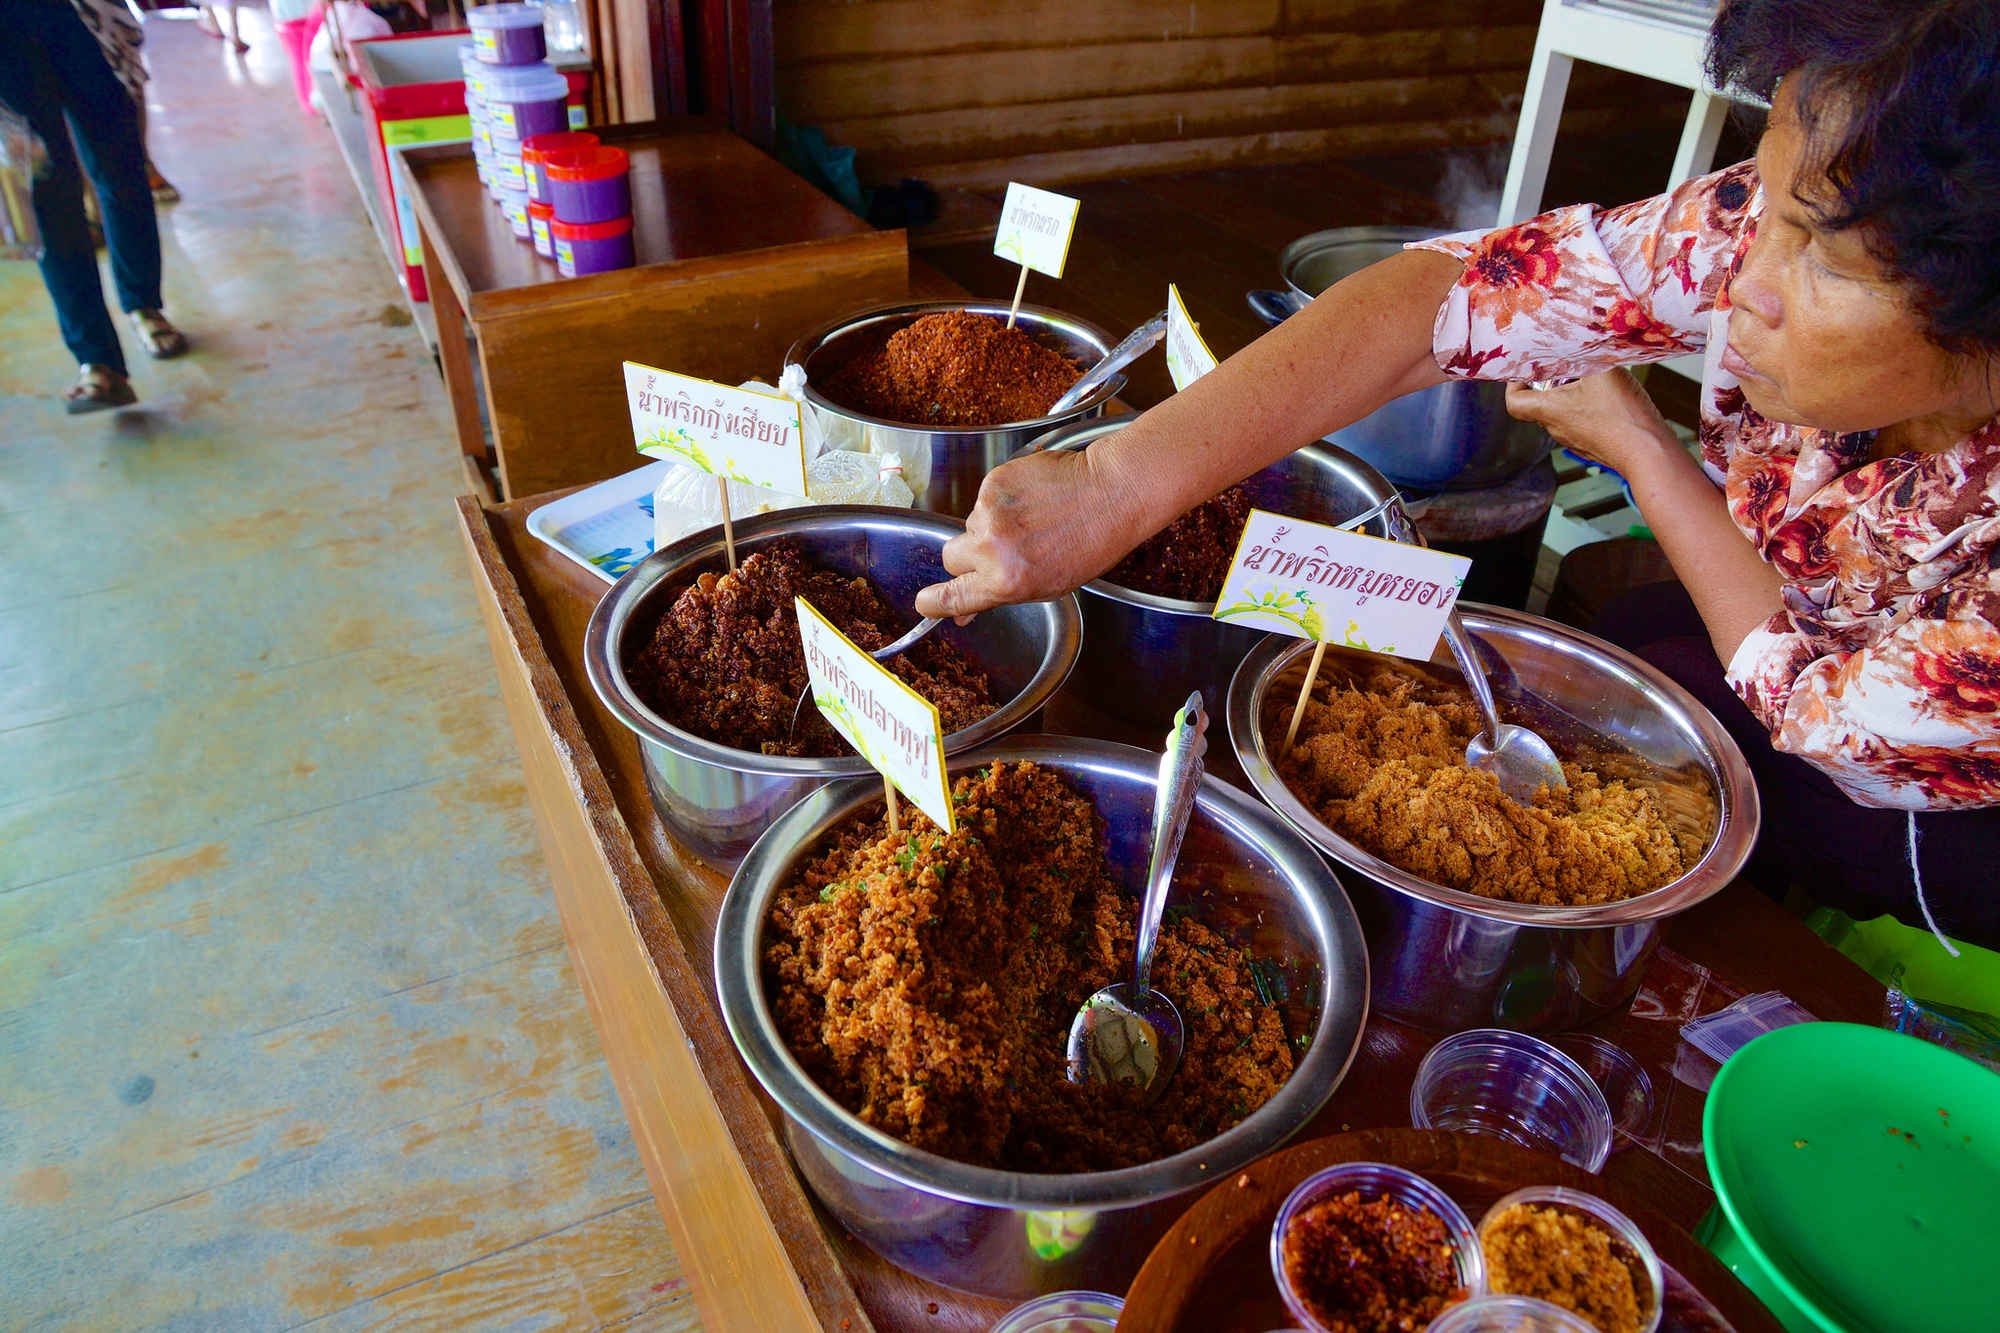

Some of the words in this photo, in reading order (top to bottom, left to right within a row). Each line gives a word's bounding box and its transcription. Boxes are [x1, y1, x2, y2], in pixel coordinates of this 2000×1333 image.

[1243, 525, 1455, 609] น้ำพริกหมูหยอง
[808, 621, 929, 779] น้ำพริกปลาทูฟู
